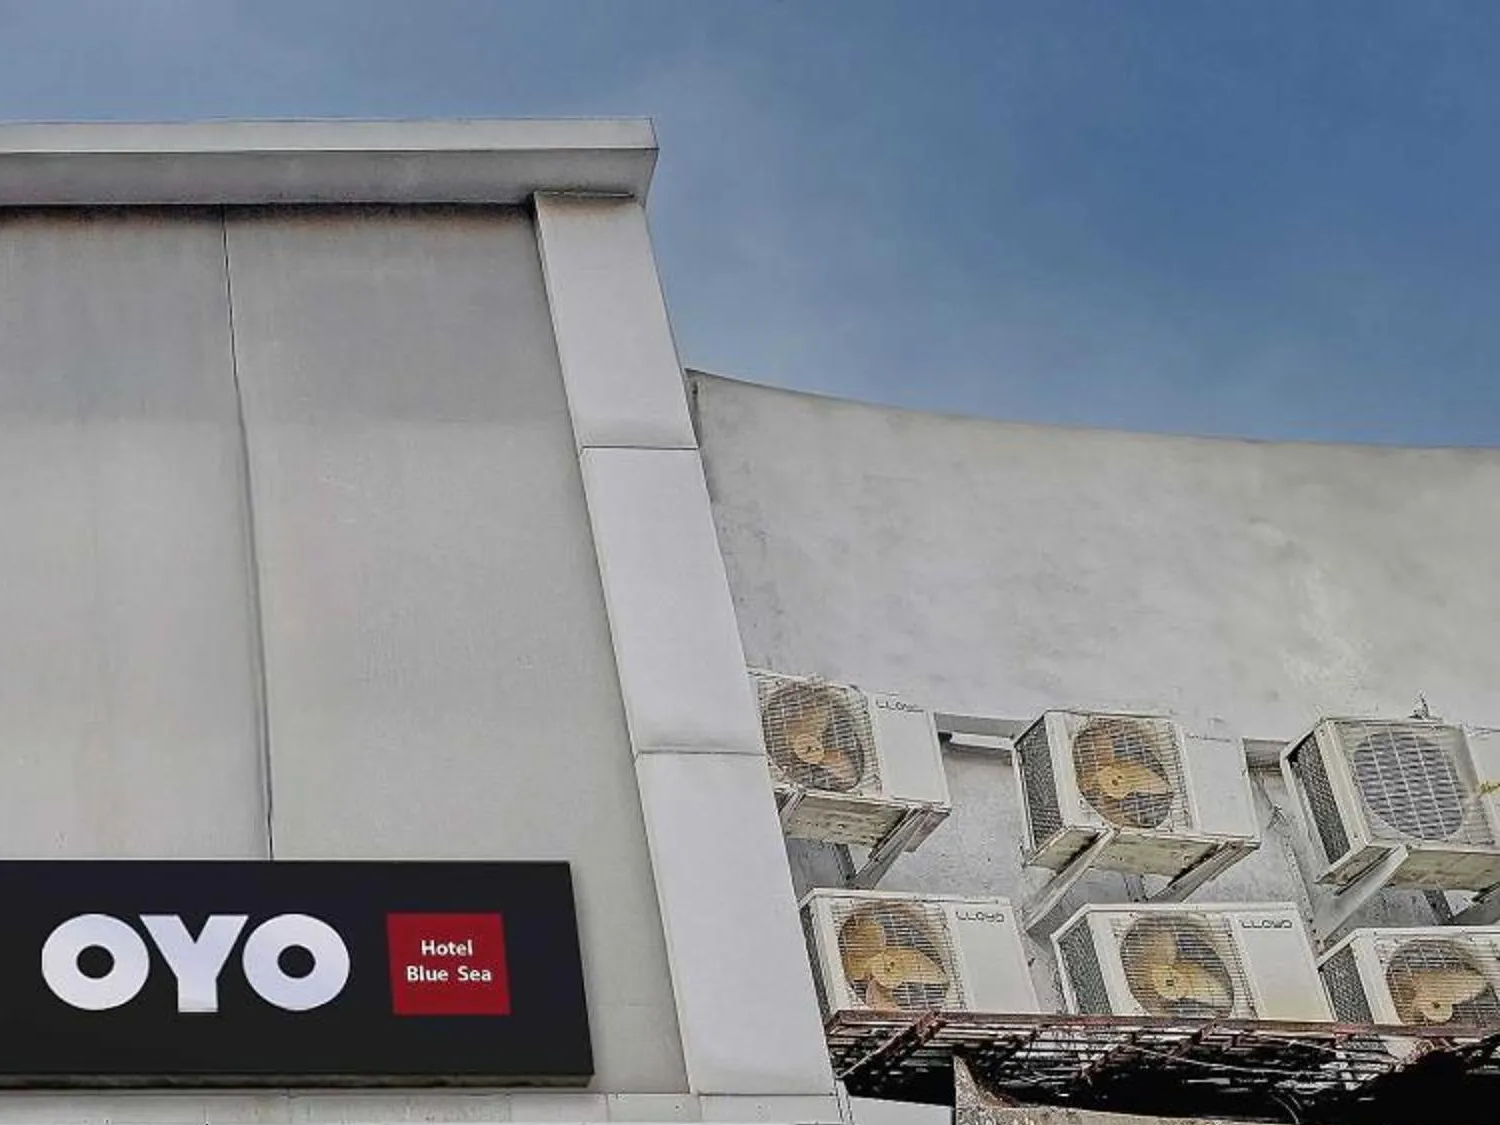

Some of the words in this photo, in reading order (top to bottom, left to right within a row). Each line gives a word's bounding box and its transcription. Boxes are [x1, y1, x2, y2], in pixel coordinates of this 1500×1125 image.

[420, 938, 474, 956] Hotel
[41, 913, 351, 1013] OYO
[406, 964, 449, 982] Blue
[457, 964, 493, 982] Sea
